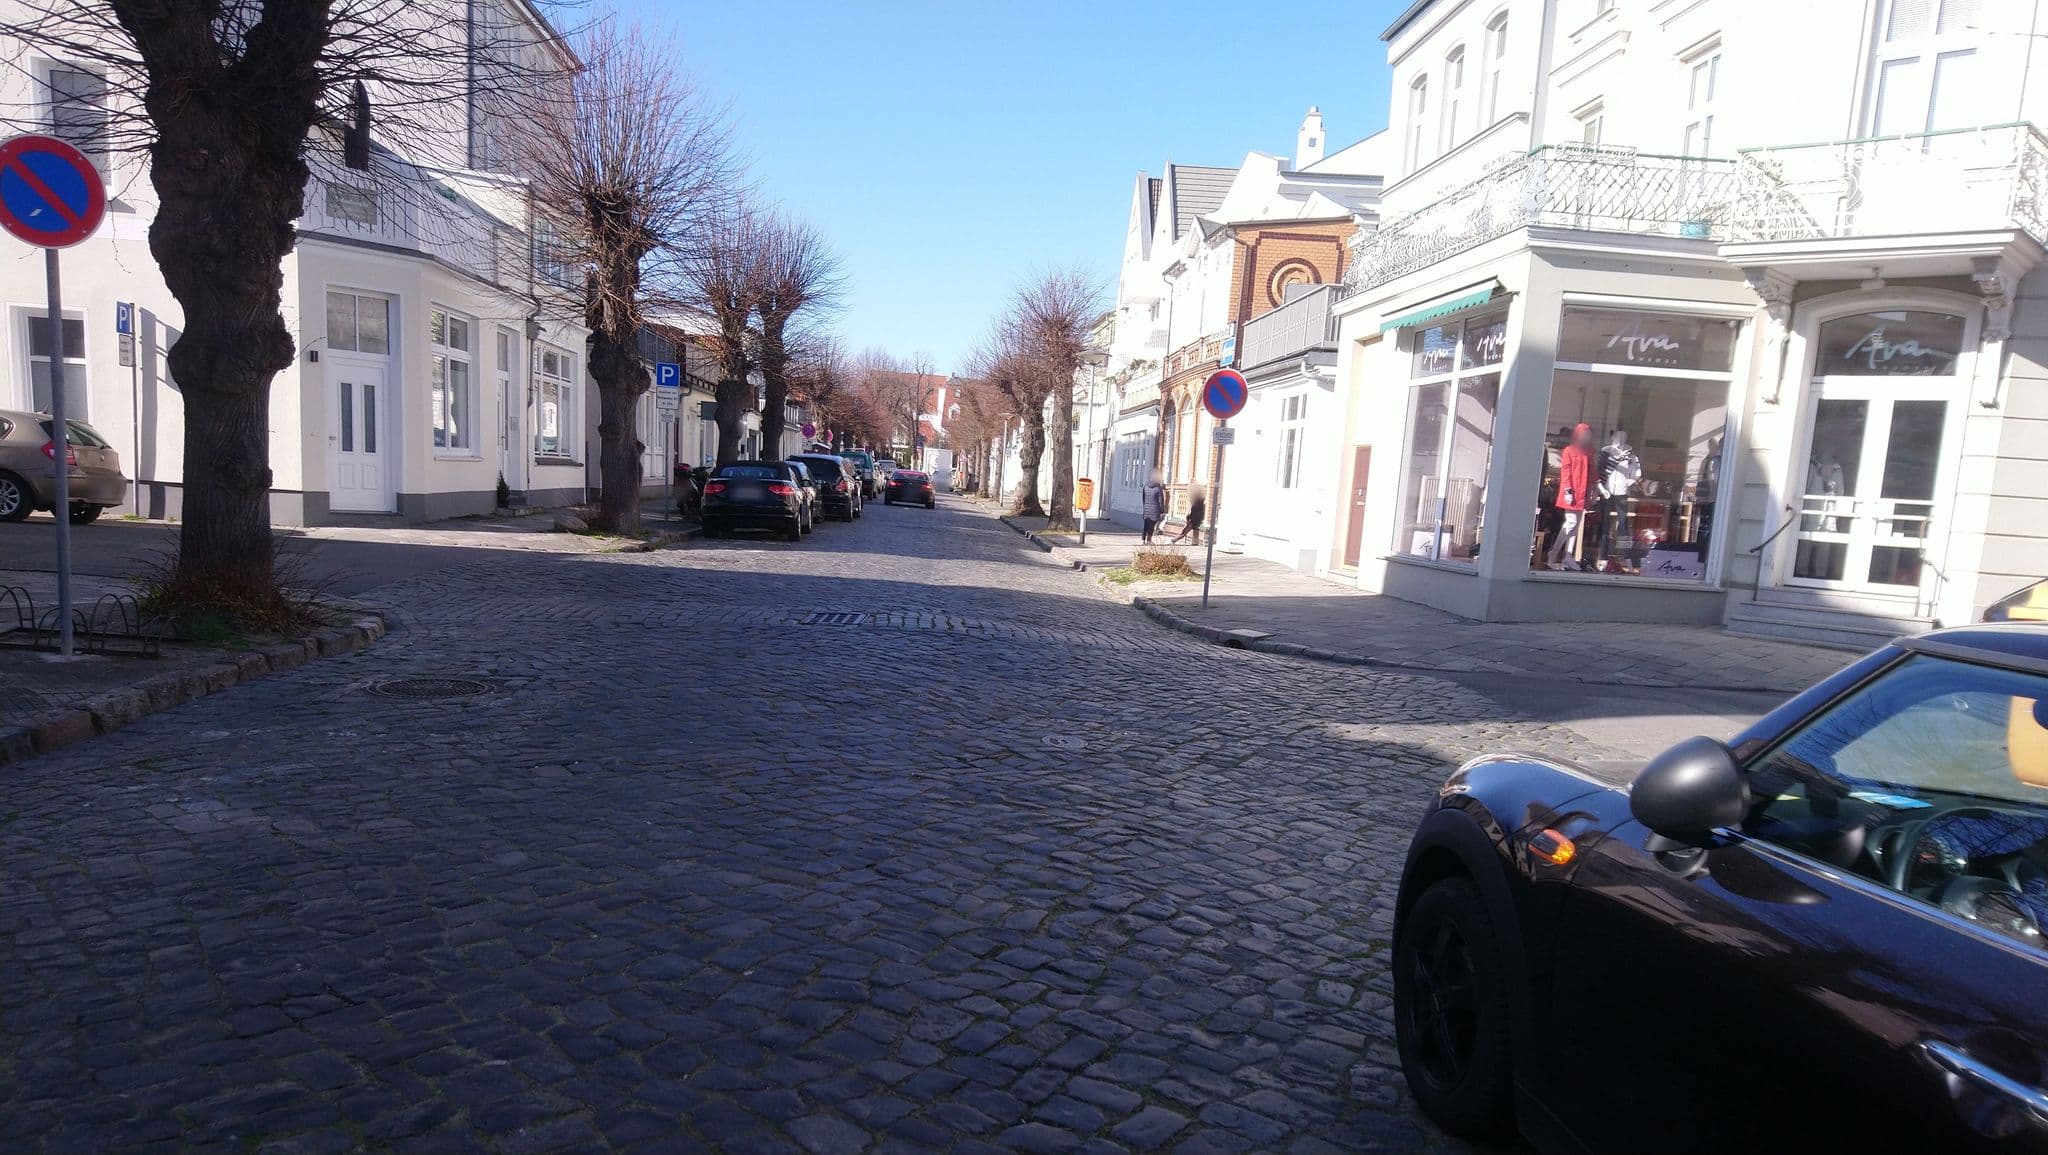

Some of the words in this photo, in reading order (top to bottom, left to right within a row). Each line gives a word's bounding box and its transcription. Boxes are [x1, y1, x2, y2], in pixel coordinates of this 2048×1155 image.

[119, 306, 128, 330] P
[1844, 323, 1953, 370] Ava
[661, 366, 675, 384] P
